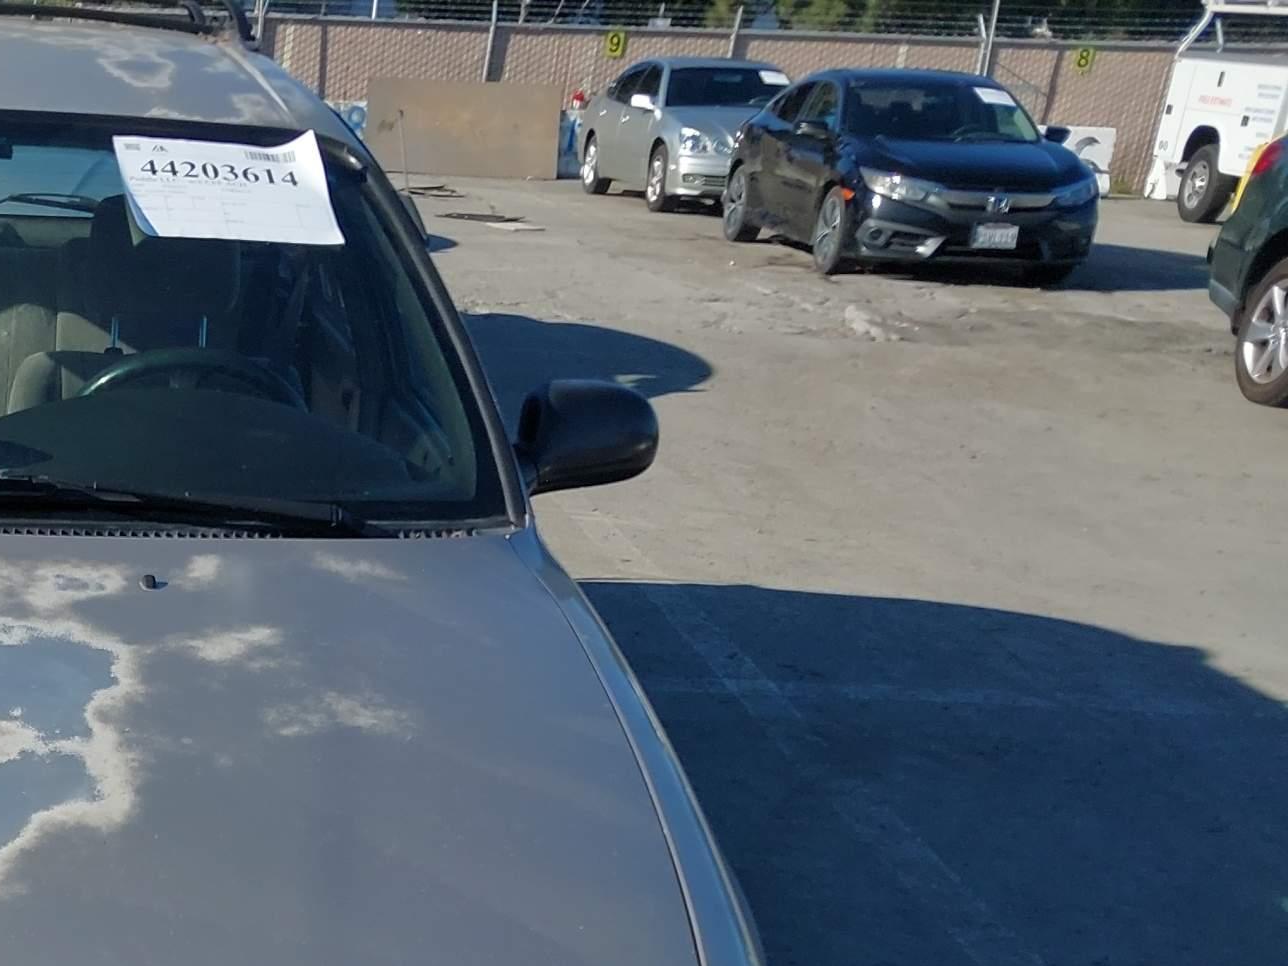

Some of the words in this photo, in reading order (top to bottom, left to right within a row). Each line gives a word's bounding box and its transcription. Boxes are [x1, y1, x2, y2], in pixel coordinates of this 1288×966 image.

[609, 33, 621, 53] 9
[1077, 49, 1090, 68] 8
[140, 159, 299, 187] 44203614
